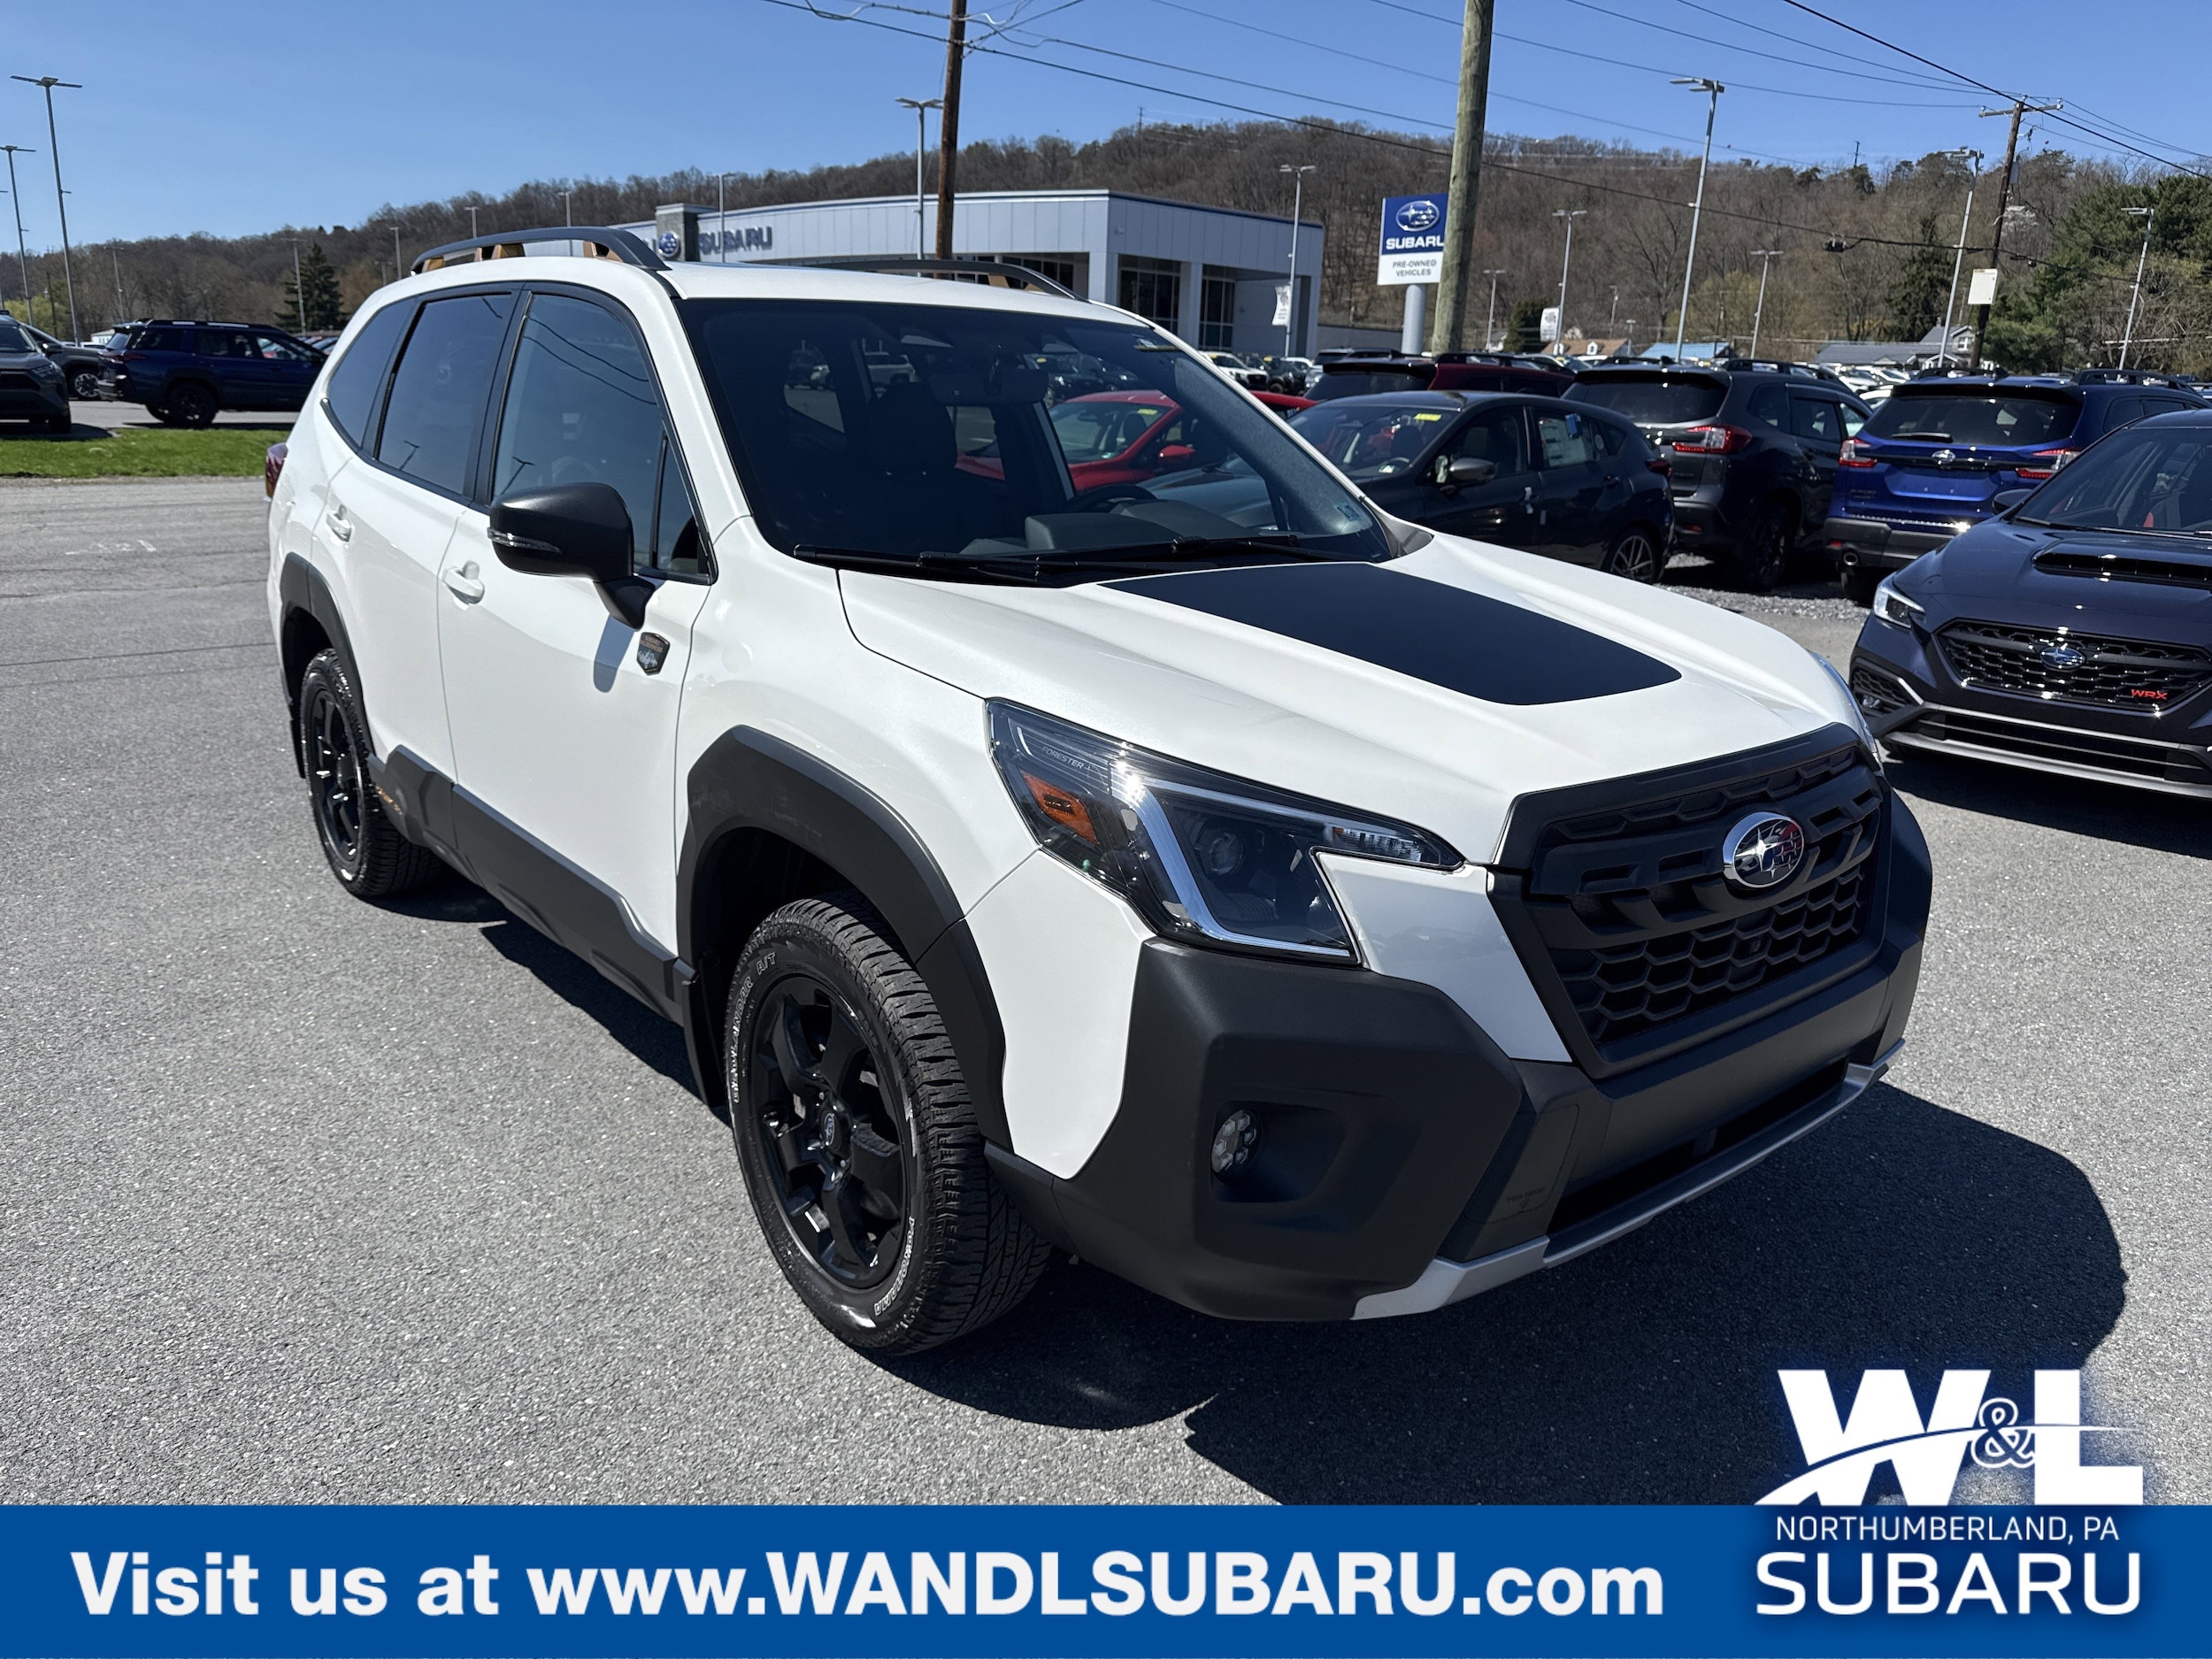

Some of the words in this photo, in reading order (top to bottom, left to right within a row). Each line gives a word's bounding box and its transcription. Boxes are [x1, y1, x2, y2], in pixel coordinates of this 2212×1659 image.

[698, 227, 772, 255] SUBARU
[1393, 259, 1437, 268] PRE-OWNED
[2131, 689, 2167, 699] WRX
[1041, 746, 1085, 769] FORESTER
